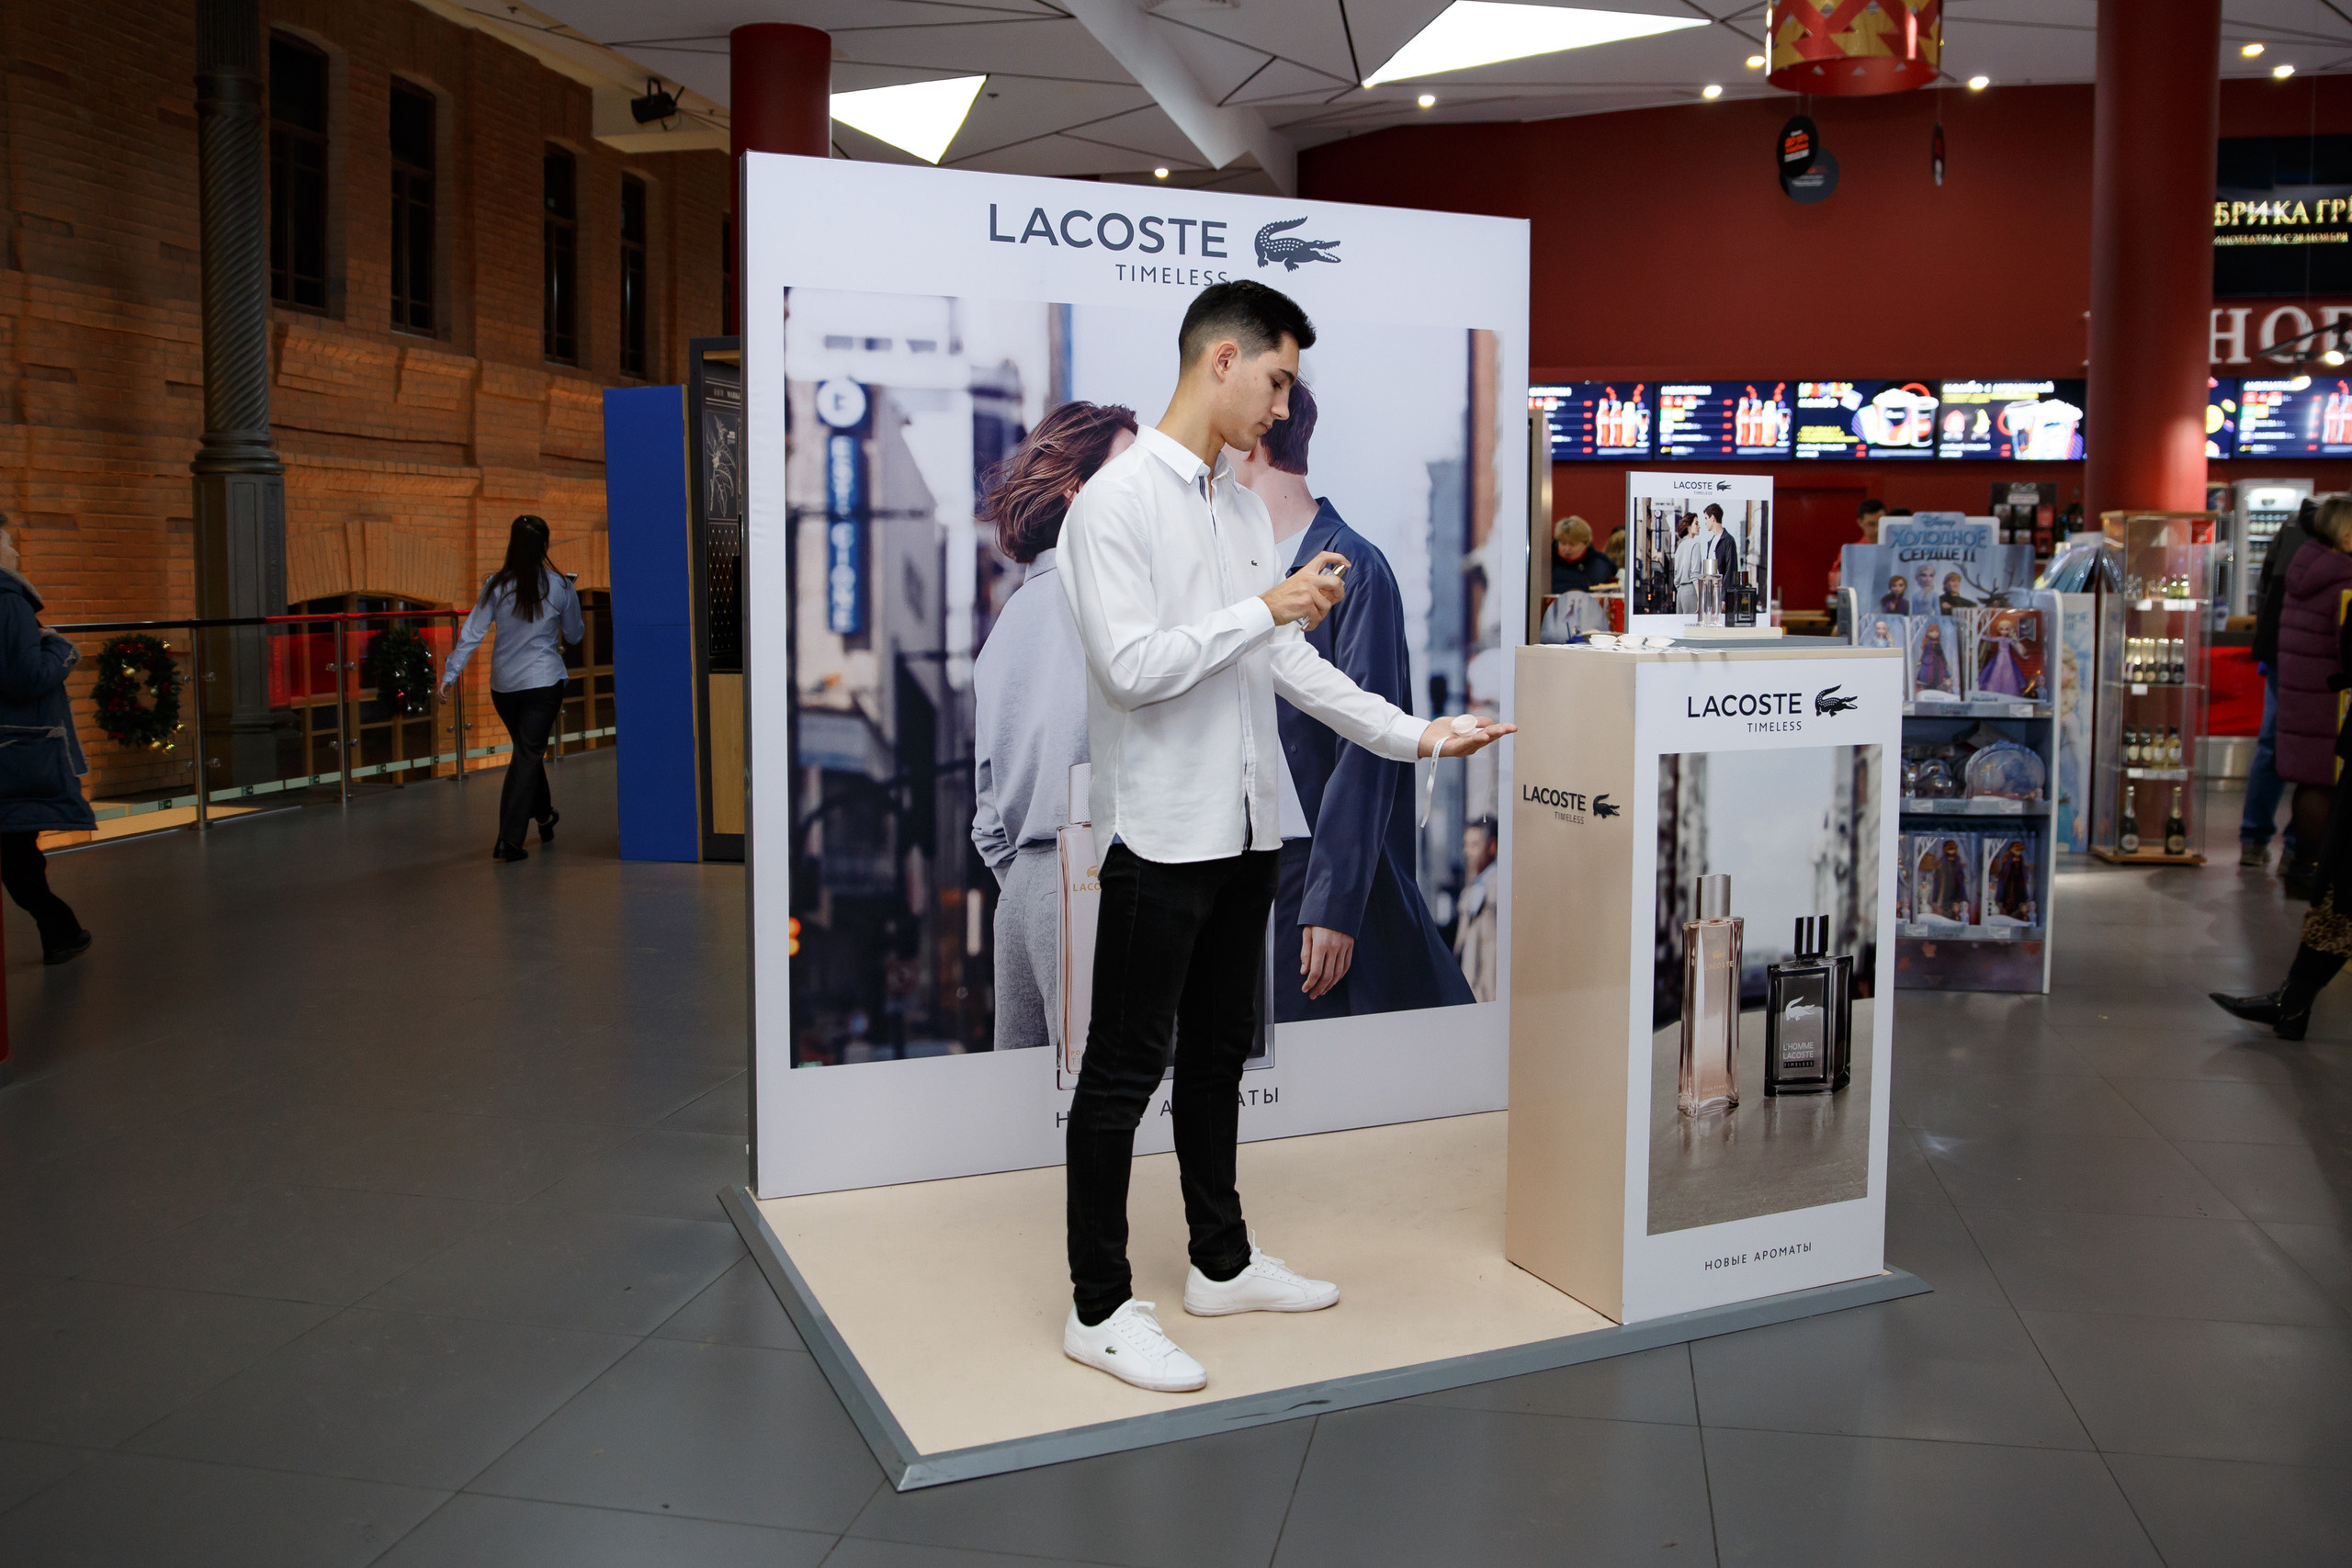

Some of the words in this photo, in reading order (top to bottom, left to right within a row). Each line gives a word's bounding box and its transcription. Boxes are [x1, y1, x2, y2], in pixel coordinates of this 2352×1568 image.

[2213, 199, 2311, 227] БРИКА
[989, 203, 1227, 259] LACOSTE
[1114, 263, 1228, 287] TIMELESS
[1673, 480, 1713, 491] LACOSTE
[1890, 528, 1988, 549] ХОЛОДНОЕ
[1899, 548, 1961, 563] СЕРДЦЕ
[1687, 692, 1803, 718] LACOSTE
[1747, 720, 1803, 734] TIMELESS
[1522, 784, 1587, 812] LACOSTE
[1554, 810, 1585, 825] TIMELESS
[1072, 882, 1102, 892] LACO
[1782, 1041, 1815, 1052] L'HOMME
[1782, 1050, 1815, 1060] LACOSTE
[1704, 1253, 1747, 1271] НОВЫЕ
[1753, 1241, 1813, 1262] АРОМАТЫ
